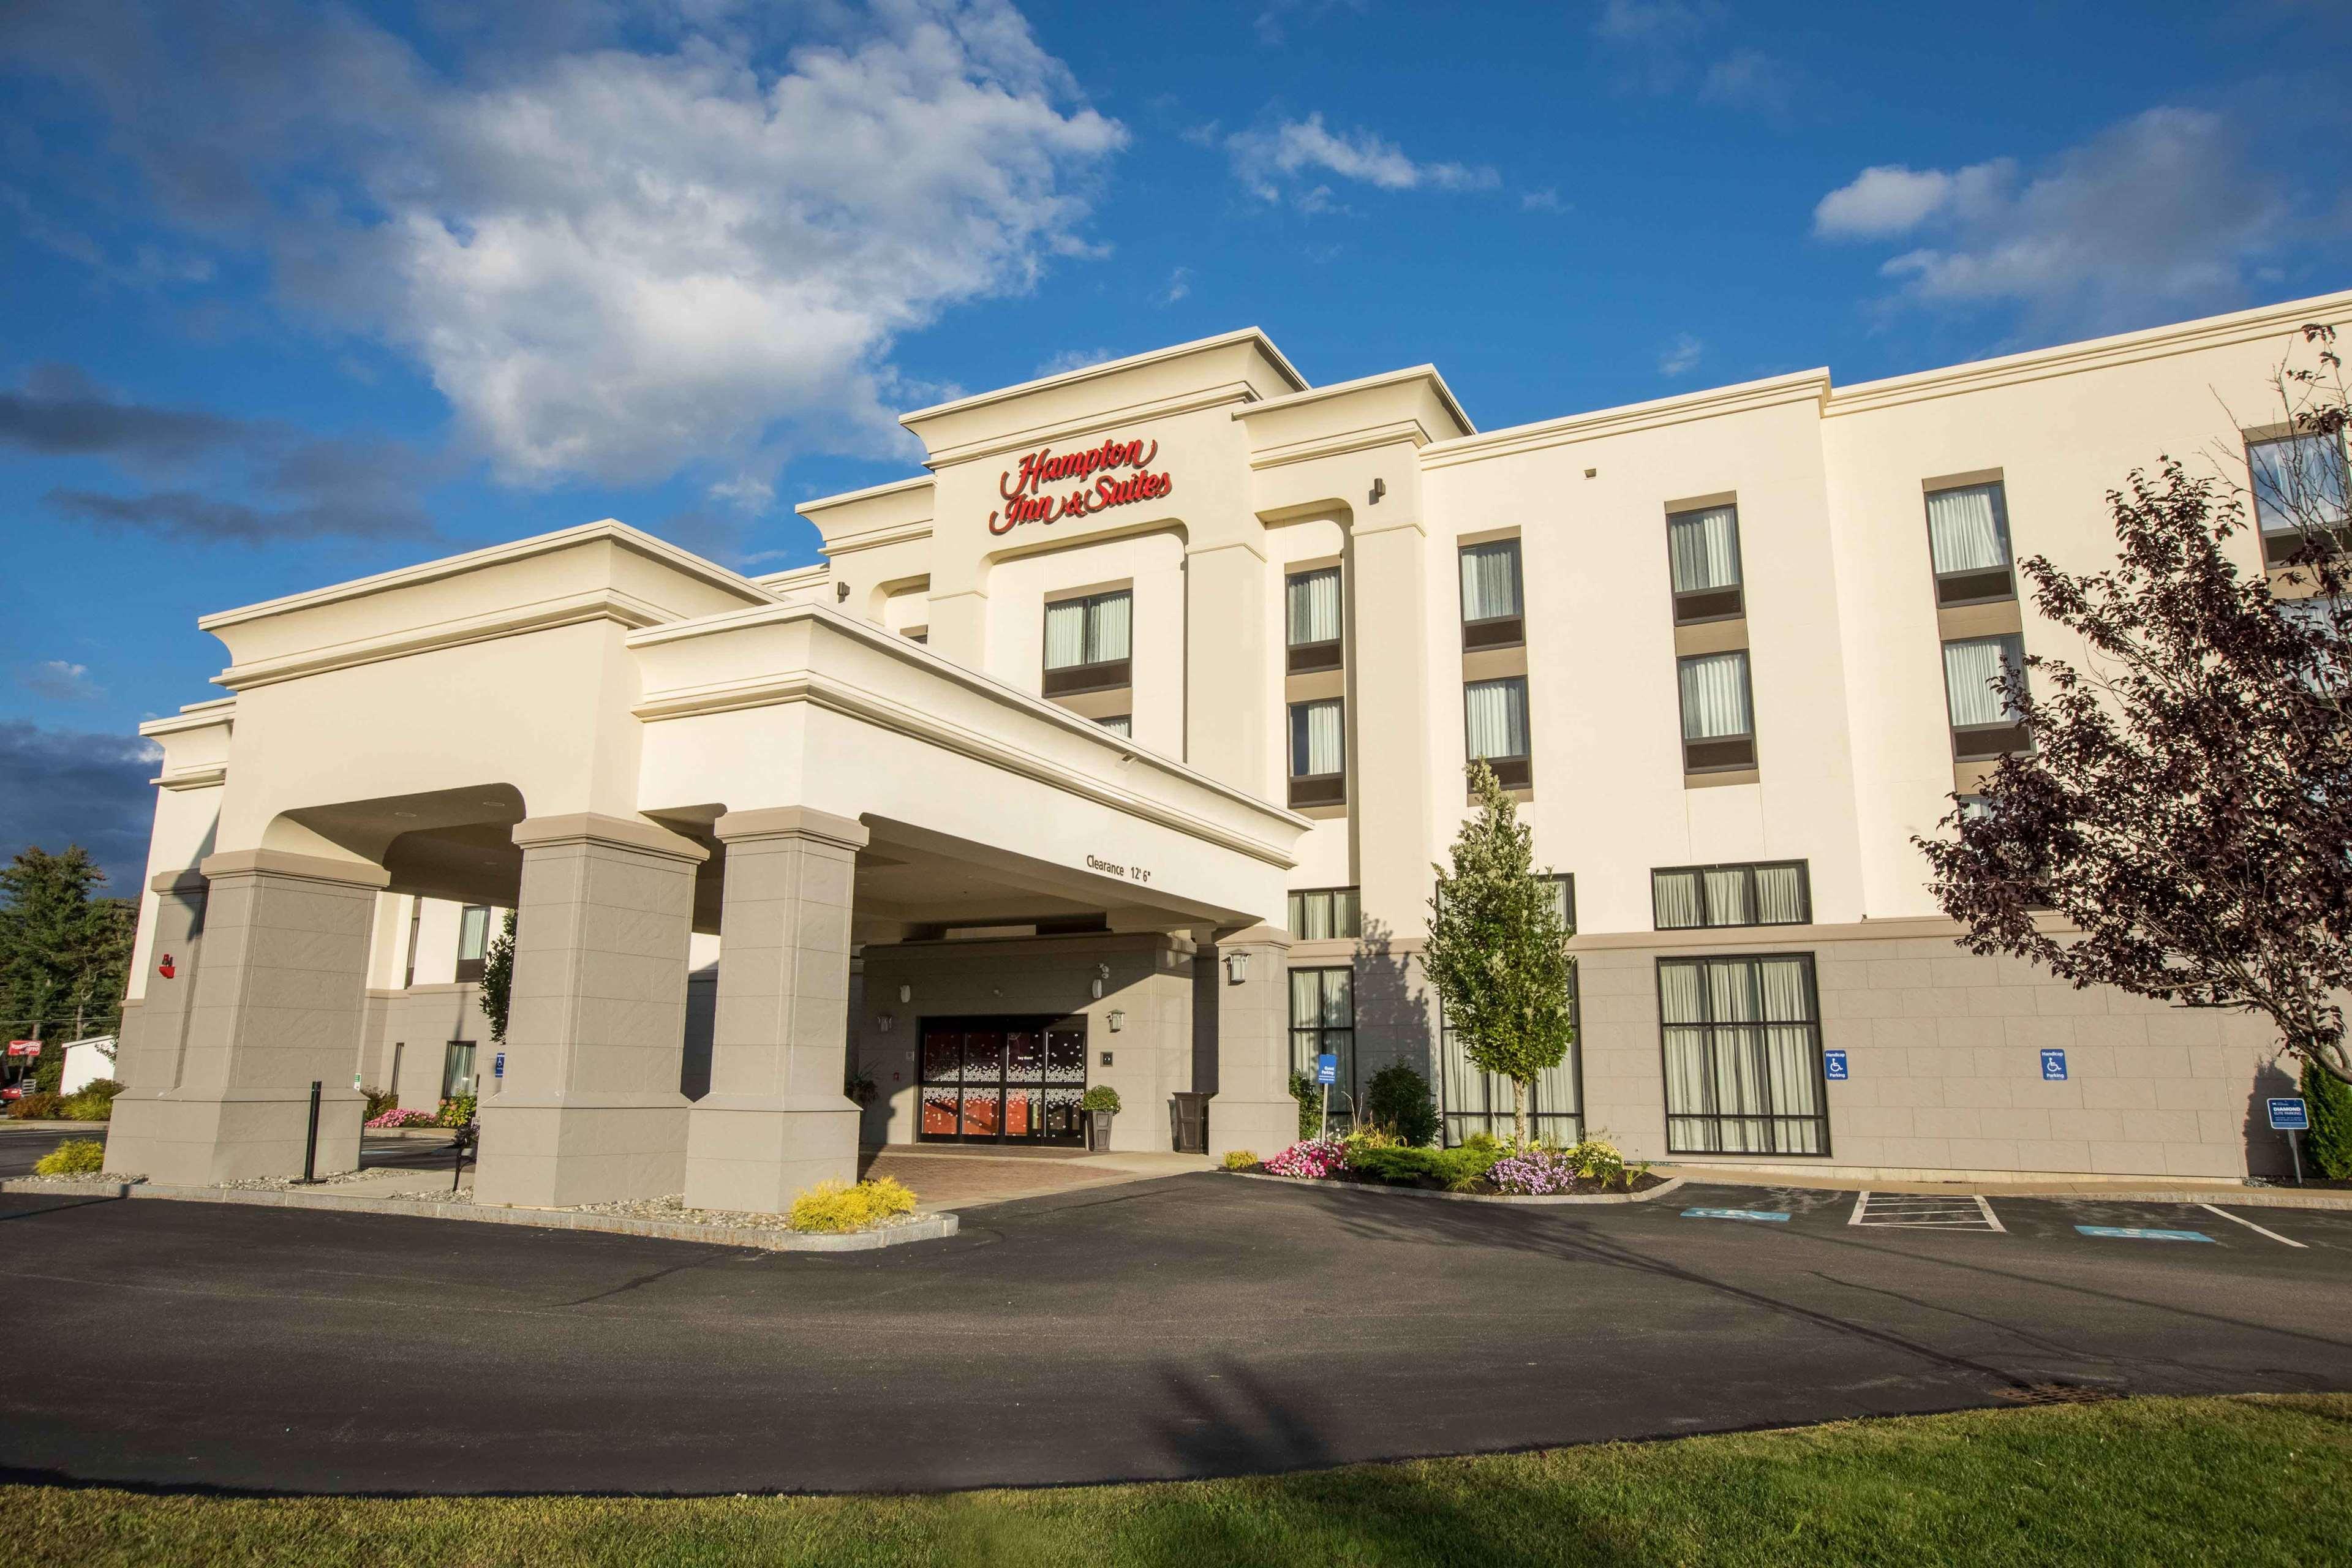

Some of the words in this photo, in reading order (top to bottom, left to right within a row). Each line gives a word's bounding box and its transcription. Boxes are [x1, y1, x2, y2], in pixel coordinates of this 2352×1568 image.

[1000, 439, 1157, 499] Hampton
[989, 494, 1068, 535] Inn
[1065, 491, 1087, 516] &
[1084, 470, 1172, 513] Suites
[1087, 854, 1124, 876] Clearance
[1131, 867, 1141, 880] 12'
